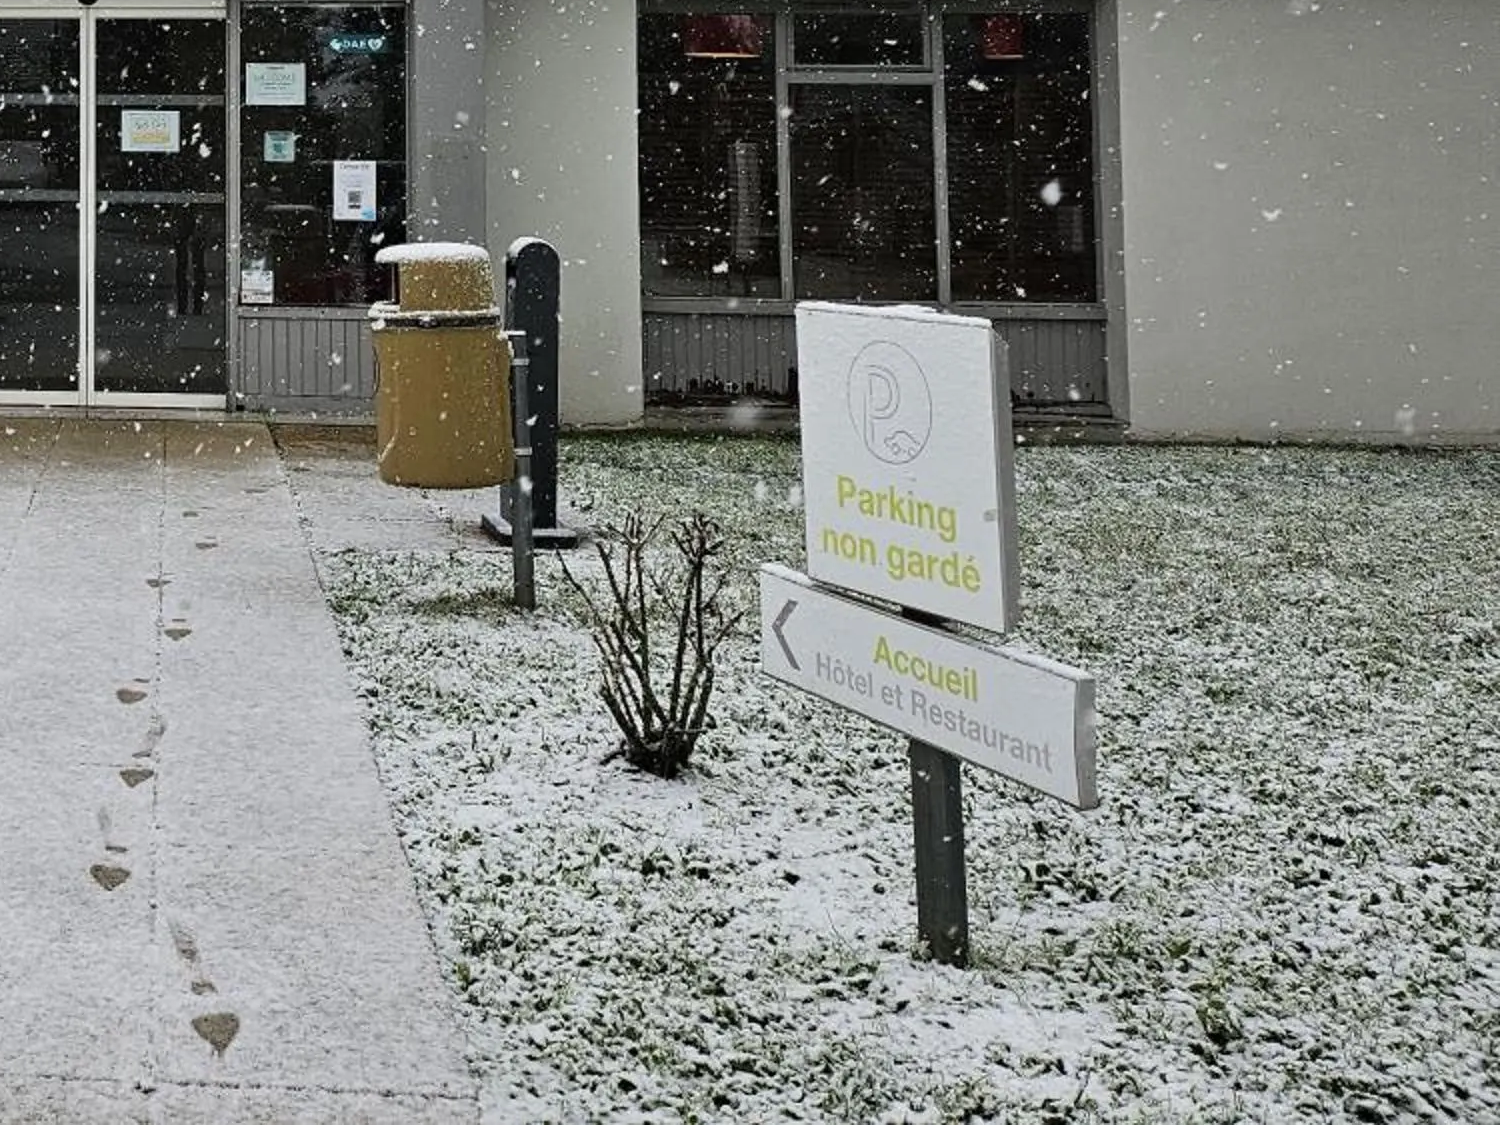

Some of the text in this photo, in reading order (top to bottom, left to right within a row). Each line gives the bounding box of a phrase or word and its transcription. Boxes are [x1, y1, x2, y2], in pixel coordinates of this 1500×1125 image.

[836, 474, 958, 544] Parking
[822, 526, 981, 594] non gardé
[872, 634, 979, 703] Accueil
[815, 651, 1053, 774] Hôtel et Restaurant
